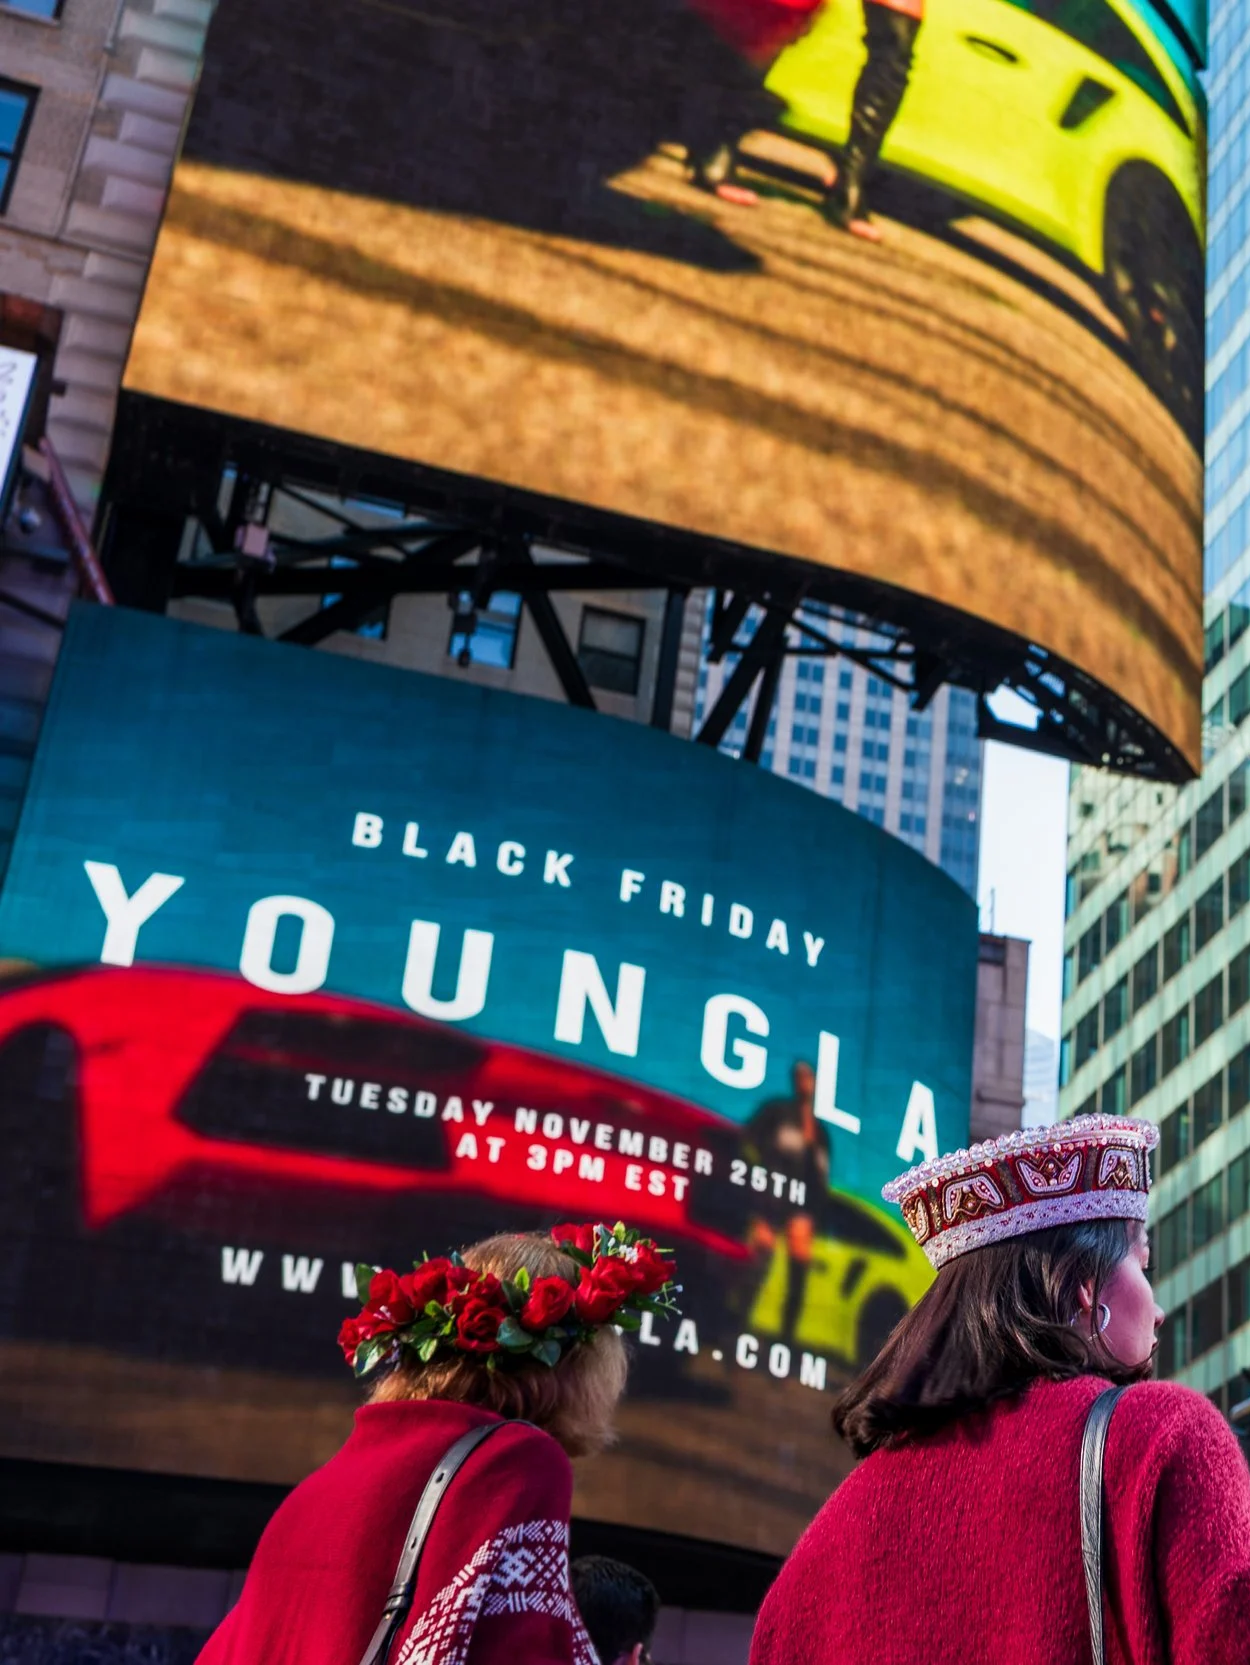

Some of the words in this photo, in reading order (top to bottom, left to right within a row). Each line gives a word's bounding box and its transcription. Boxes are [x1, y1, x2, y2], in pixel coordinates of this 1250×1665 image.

[353, 812, 575, 888] BLACK
[620, 868, 825, 967] FRIDAY
[84, 860, 939, 1164] YOUNGLA
[305, 1074, 494, 1127] TUESDAY
[514, 1108, 713, 1176] NOVEMBER
[730, 1160, 806, 1206] 25TH
[456, 1133, 506, 1163] AT
[527, 1144, 605, 1183] 3PM
[624, 1165, 690, 1202] EST
